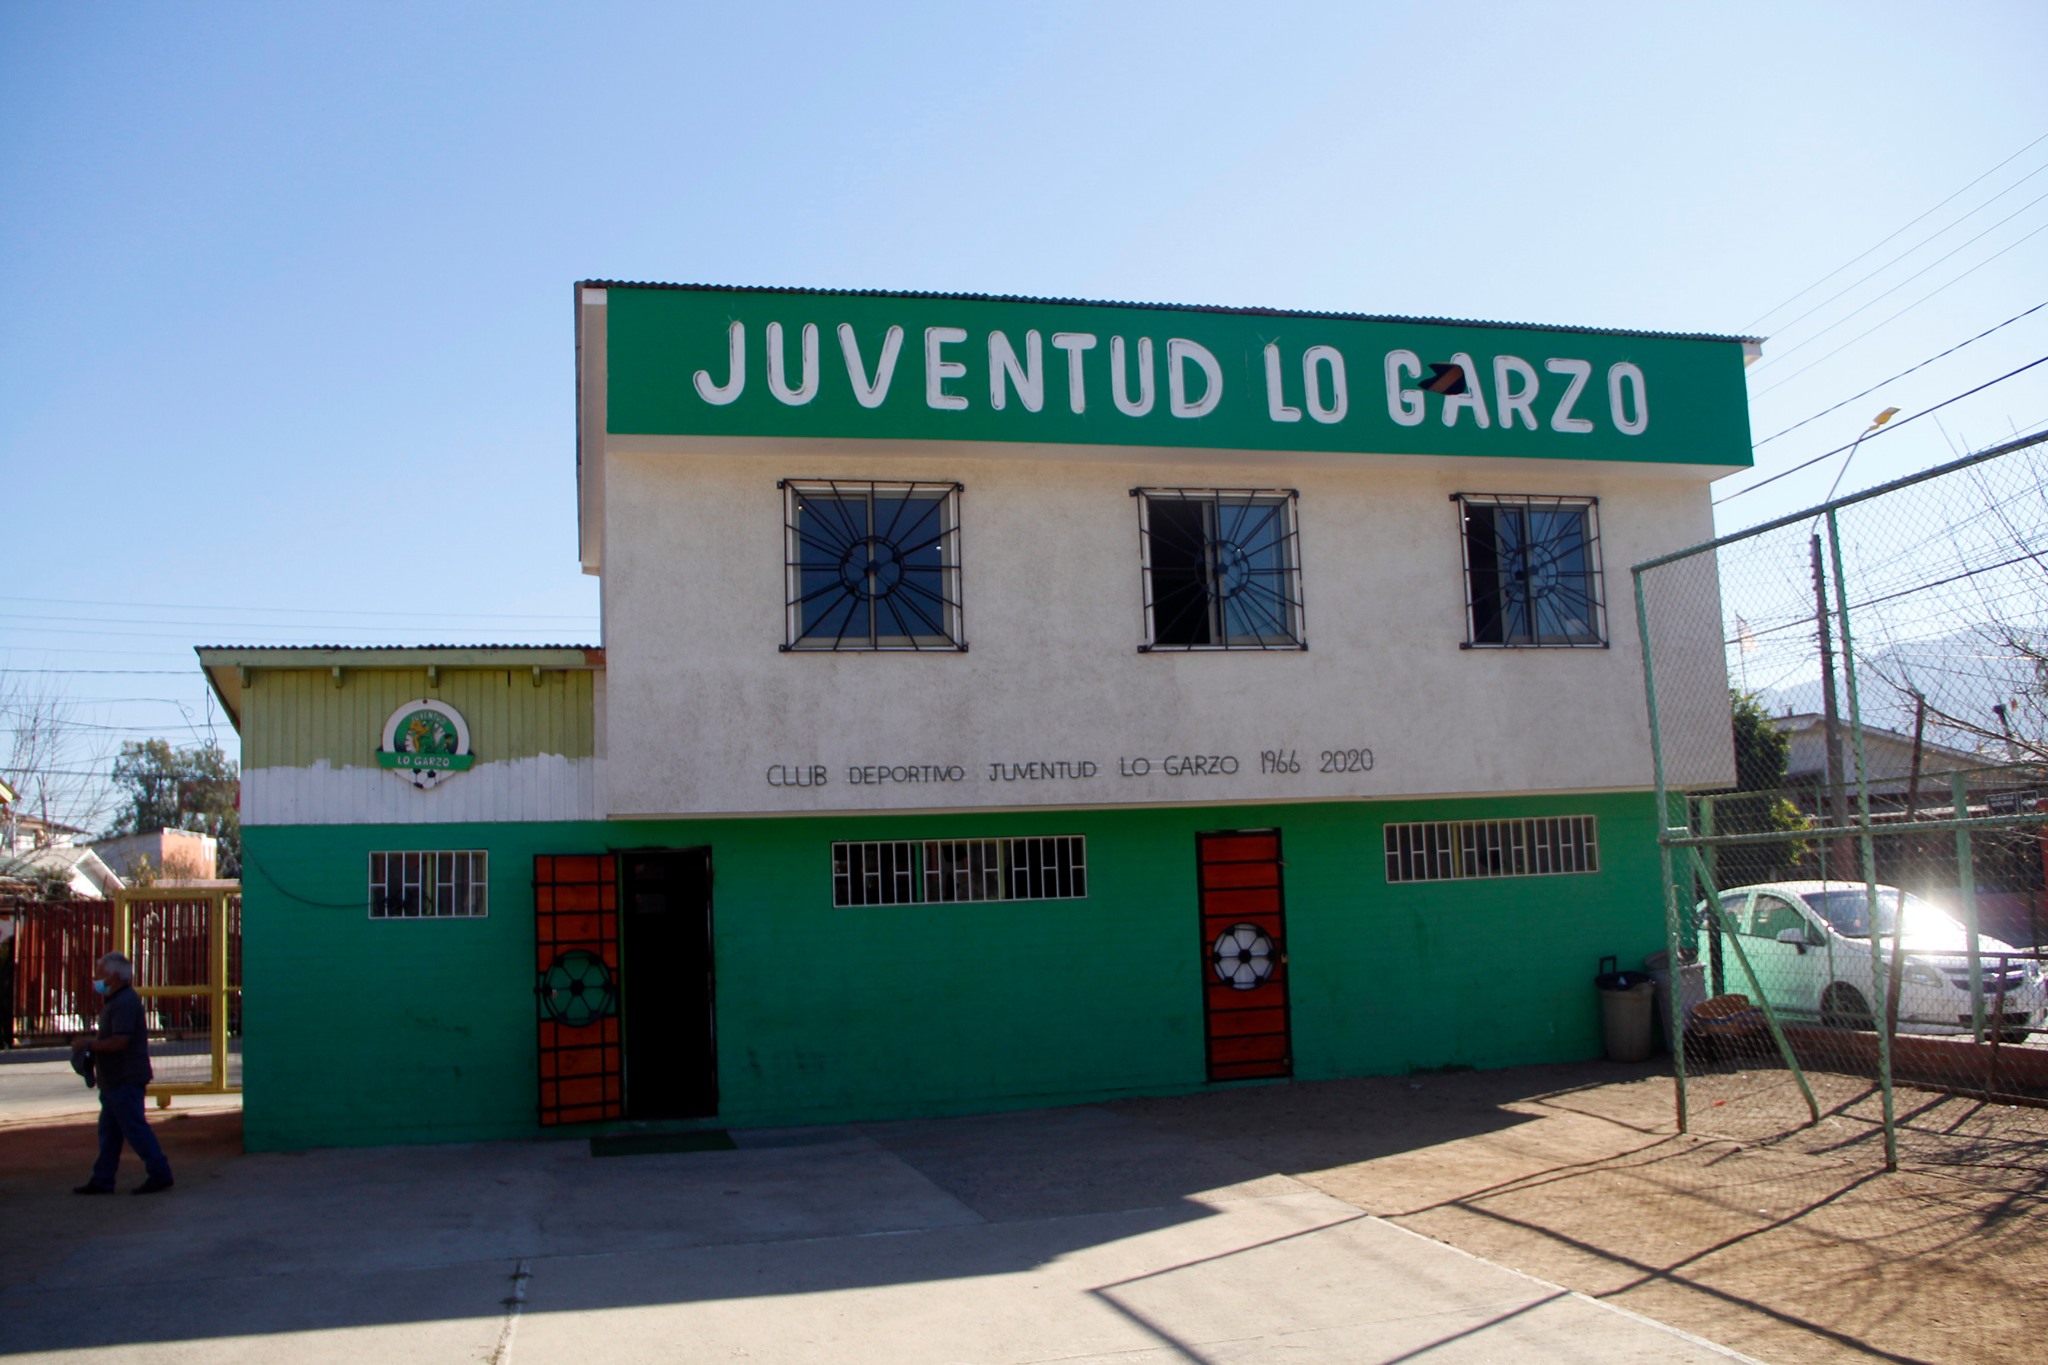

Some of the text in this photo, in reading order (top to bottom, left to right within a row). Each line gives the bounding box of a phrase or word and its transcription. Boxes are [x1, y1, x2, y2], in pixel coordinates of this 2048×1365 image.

[693, 321, 1648, 435] JUVENTUD LO GARZO
[411, 711, 447, 724] JUVENTUD
[397, 755, 450, 767] LO GARZO
[766, 748, 1374, 787] CLUB DEPORTIVO JUVENTUD LO GARZO 1966 2020
